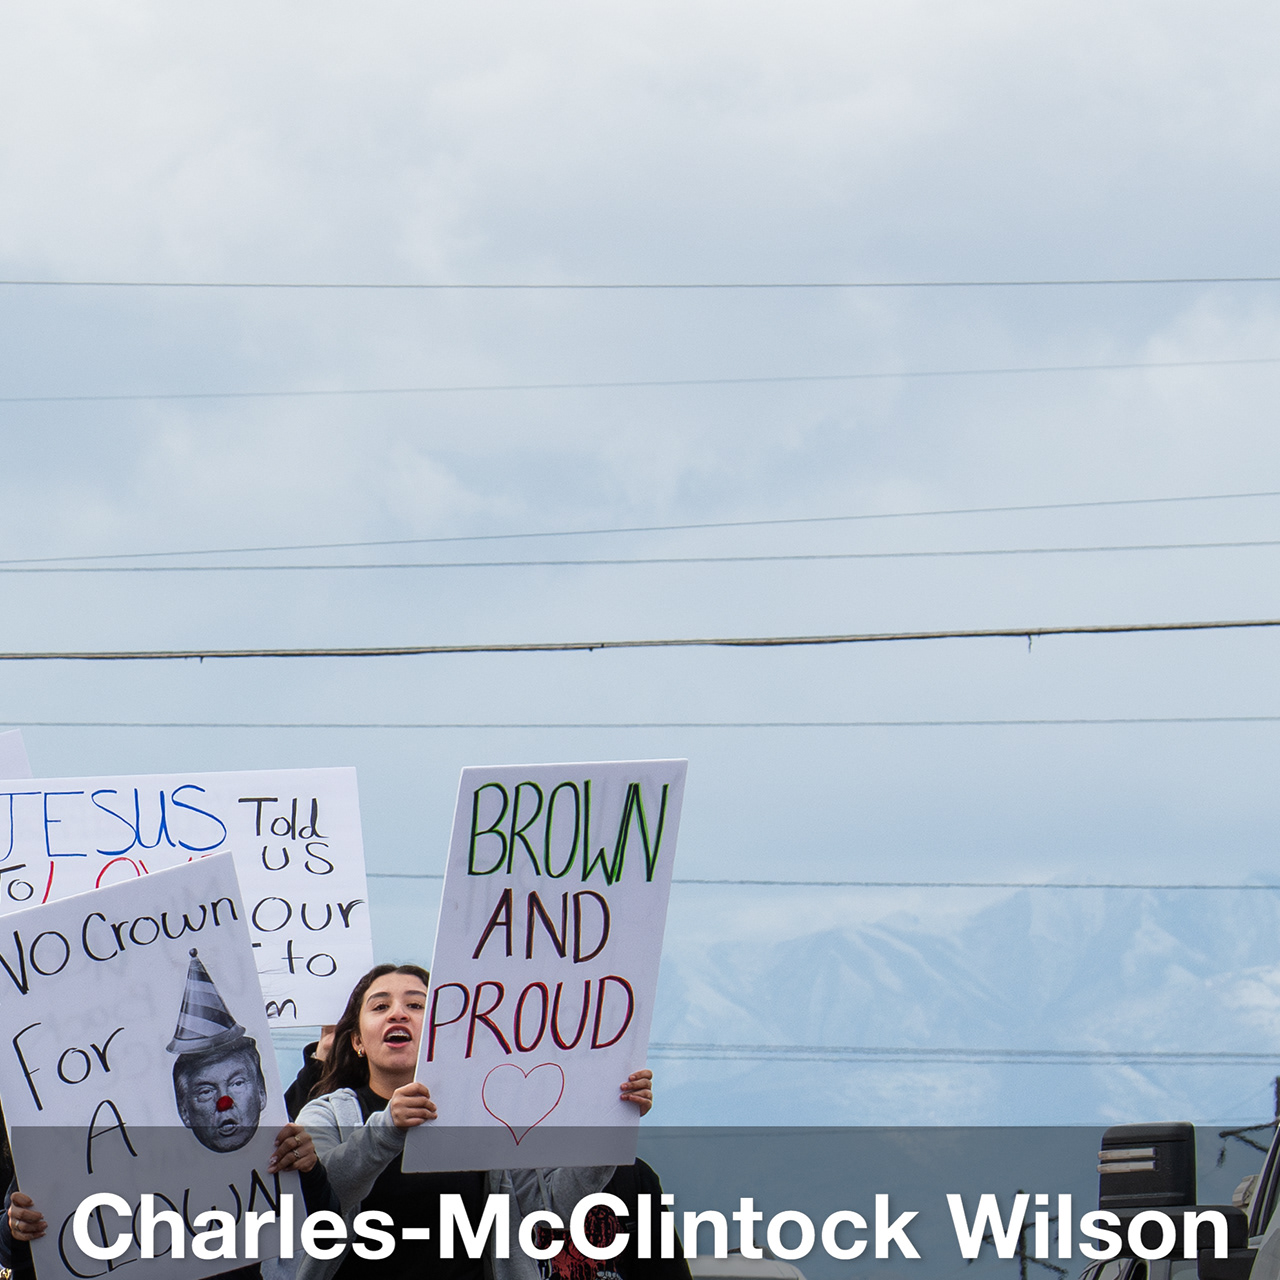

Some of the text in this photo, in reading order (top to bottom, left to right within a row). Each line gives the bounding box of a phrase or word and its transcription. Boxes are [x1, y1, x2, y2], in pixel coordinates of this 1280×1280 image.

[238, 797, 329, 840] Told
[468, 779, 669, 886] BROWN
[81, 897, 239, 963] Crown
[472, 888, 610, 964] AND
[426, 975, 635, 1062] PROUD
[11, 1022, 124, 1111] For
[86, 1100, 137, 1175] A
